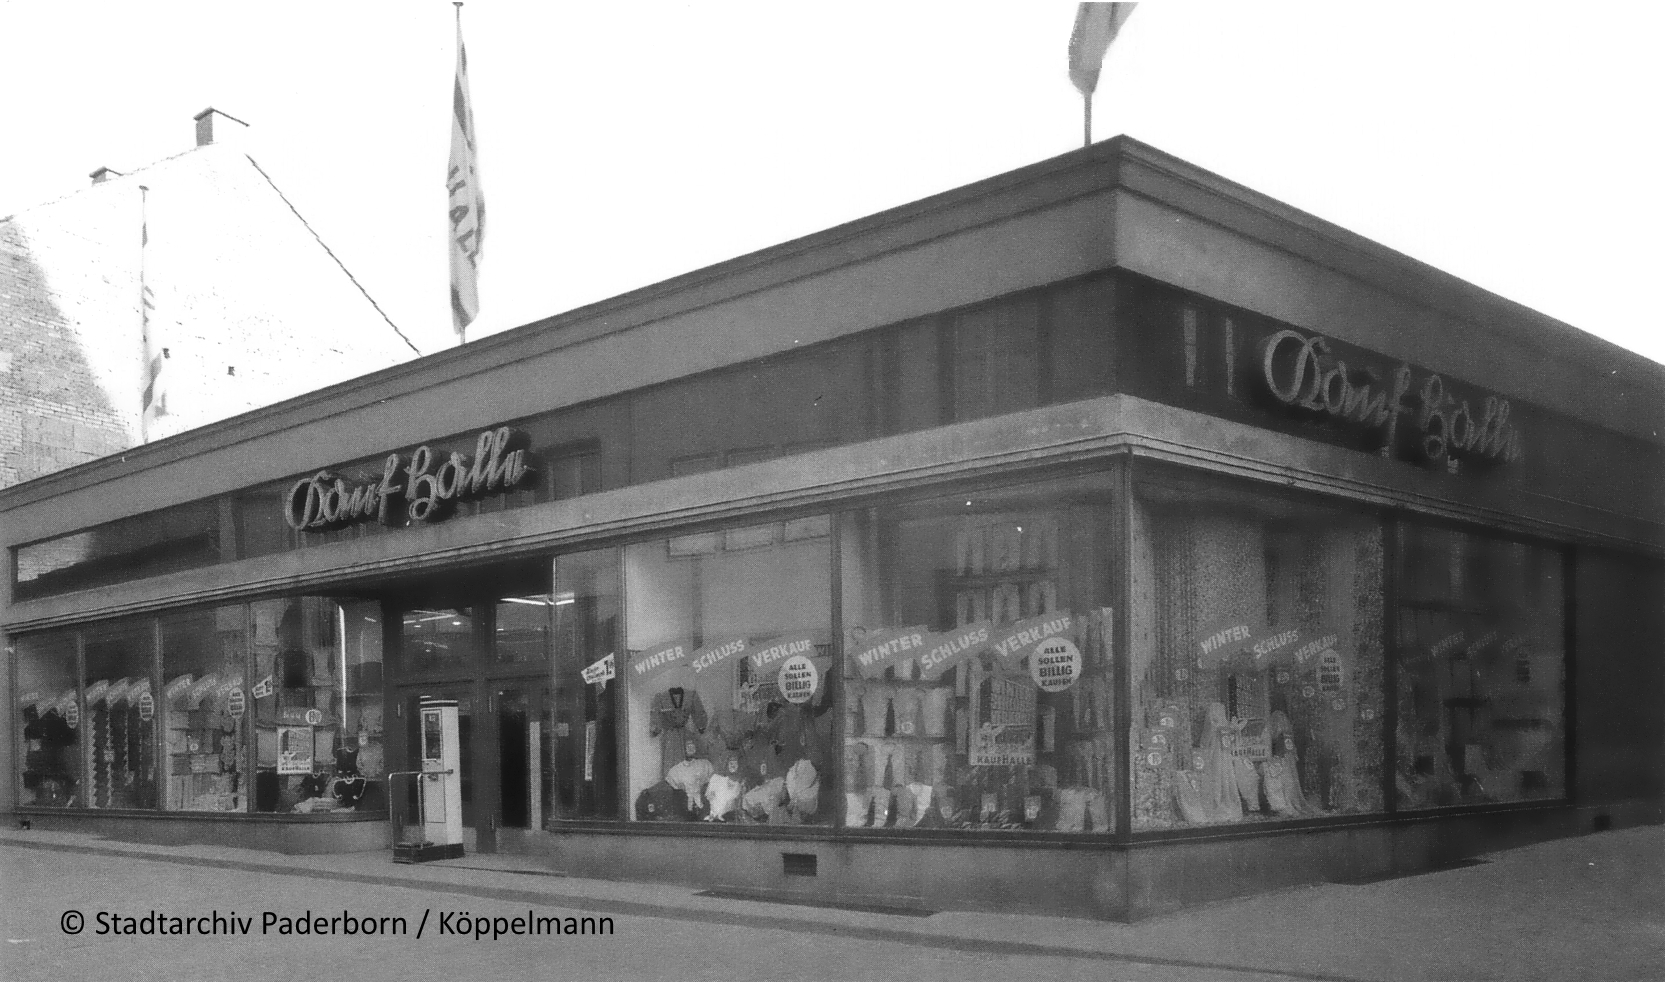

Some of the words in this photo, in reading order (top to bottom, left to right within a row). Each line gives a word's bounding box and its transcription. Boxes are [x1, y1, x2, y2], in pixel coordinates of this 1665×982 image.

[858, 634, 923, 666] WINTER
[921, 628, 989, 669] SCHLUSS
[994, 617, 1073, 657] VERKAUF
[1200, 625, 1251, 655] WINTER
[1253, 628, 1300, 659] SCHLUSS
[1043, 646, 1066, 654] ALLE
[634, 645, 684, 675] WINTER
[692, 639, 746, 673] SCHLUSS
[751, 638, 813, 667] VERKAUF
[1038, 655, 1073, 665] SOLLEN
[788, 663, 806, 671] ALLE
[1039, 666, 1073, 677] BILLIG
[784, 671, 812, 680] SOLLEN
[785, 680, 811, 691] BILLIG
[977, 754, 1032, 765] KAUFHALLE
